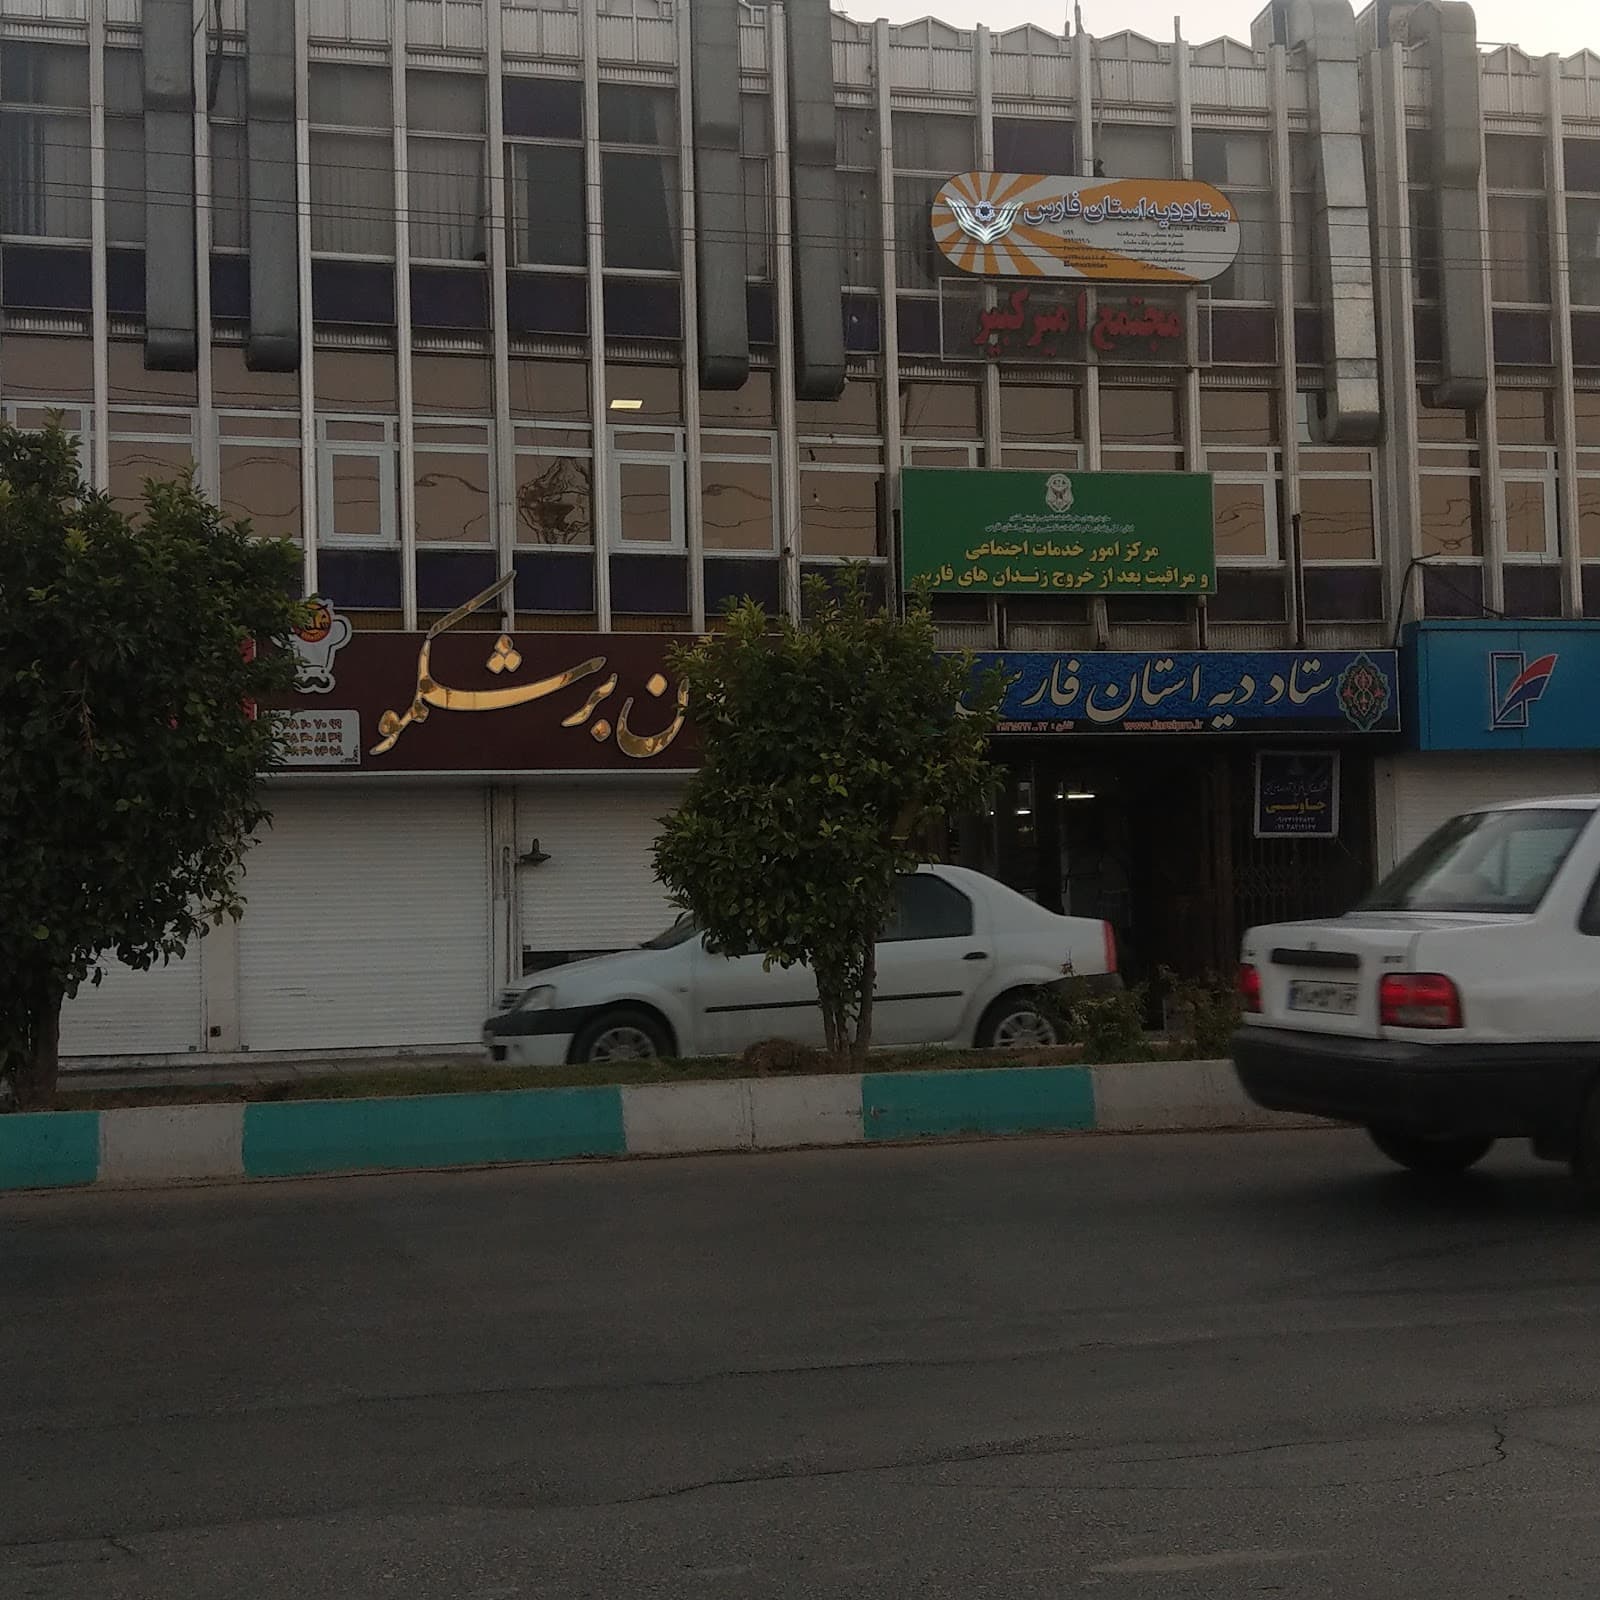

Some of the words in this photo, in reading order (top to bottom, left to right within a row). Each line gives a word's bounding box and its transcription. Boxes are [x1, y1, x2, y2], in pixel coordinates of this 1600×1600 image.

[1024, 191, 1082, 225] فارس
[1083, 195, 1146, 223] استان
[1092, 296, 1181, 351] مجتمع
[965, 539, 1028, 560] اجتماعی
[1032, 540, 1083, 557] خدمات
[1089, 540, 1120, 562] امور
[1125, 541, 1159, 562] مرکز
[958, 564, 988, 587] های
[1052, 567, 1094, 587] خروج
[1099, 567, 1113, 587] از
[1117, 570, 1141, 586] بعد
[1145, 565, 1196, 588] مراقبت
[1200, 573, 1208, 588] و
[1085, 657, 1200, 723] استان
[1264, 657, 1334, 705] ستاد
[1207, 670, 1257, 731] دیه
